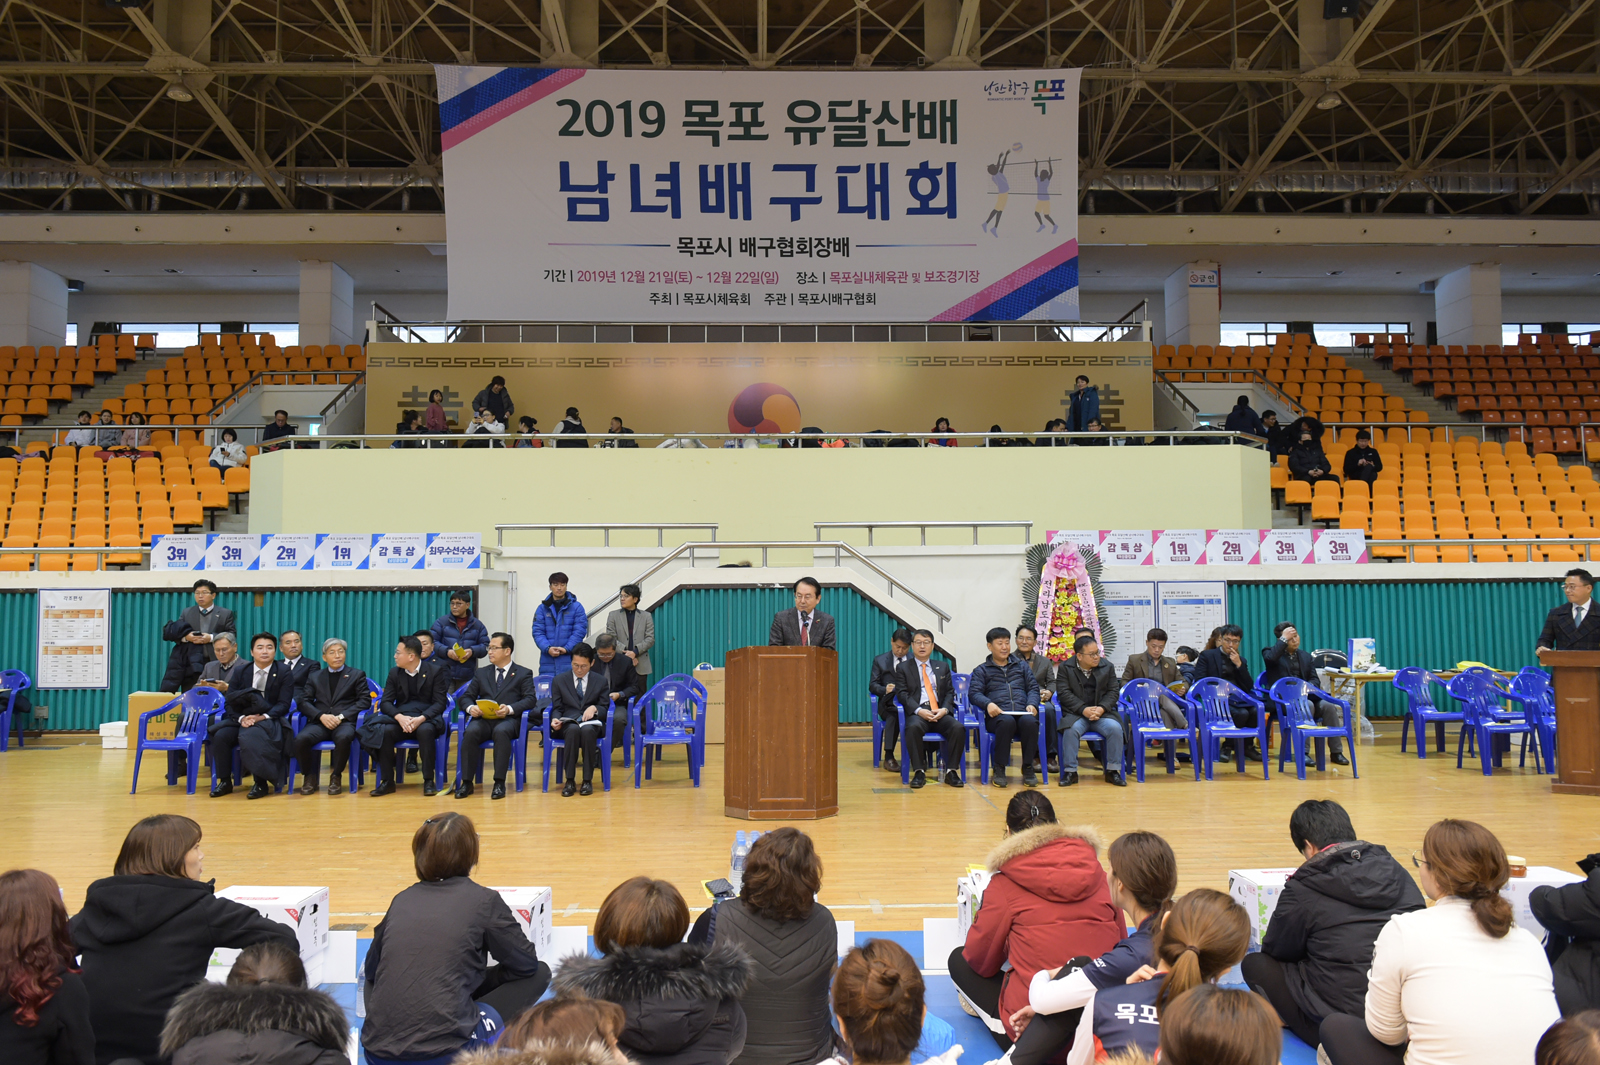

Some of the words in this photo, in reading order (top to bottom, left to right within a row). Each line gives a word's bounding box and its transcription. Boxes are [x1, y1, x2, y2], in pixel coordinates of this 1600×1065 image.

[556, 99, 666, 138] 2019
[682, 100, 769, 147] 목포
[784, 99, 958, 147] 유달산배
[559, 160, 957, 222] 남녀배구대회
[677, 236, 733, 258] 목포시
[739, 236, 850, 258] 배구협회장배
[544, 269, 566, 283] 기간
[577, 270, 616, 284] 2019년
[620, 270, 645, 284] 12월
[648, 270, 693, 285] 21일(토)
[707, 271, 732, 285] 12월
[735, 271, 779, 285] 22일(일)
[796, 271, 819, 285] 장소
[829, 270, 908, 284] 목포실내체육관
[911, 272, 921, 283] 및
[924, 270, 980, 284] 보조경기장
[1199, 274, 1215, 283] 금연
[649, 293, 672, 306] 주최
[683, 293, 751, 306] 목포시체육회
[764, 293, 787, 306] 주관
[797, 292, 876, 306] 목포시배구협회
[167, 545, 187, 561] 3위
[222, 545, 242, 561] 3위
[276, 545, 296, 560] 2위
[332, 545, 351, 560] 1위
[429, 546, 475, 556] 최우수선수상
[1169, 541, 1188, 556] 1위
[1222, 540, 1242, 555] 2위
[1275, 540, 1295, 555] 3위
[1329, 540, 1349, 555] 3위
